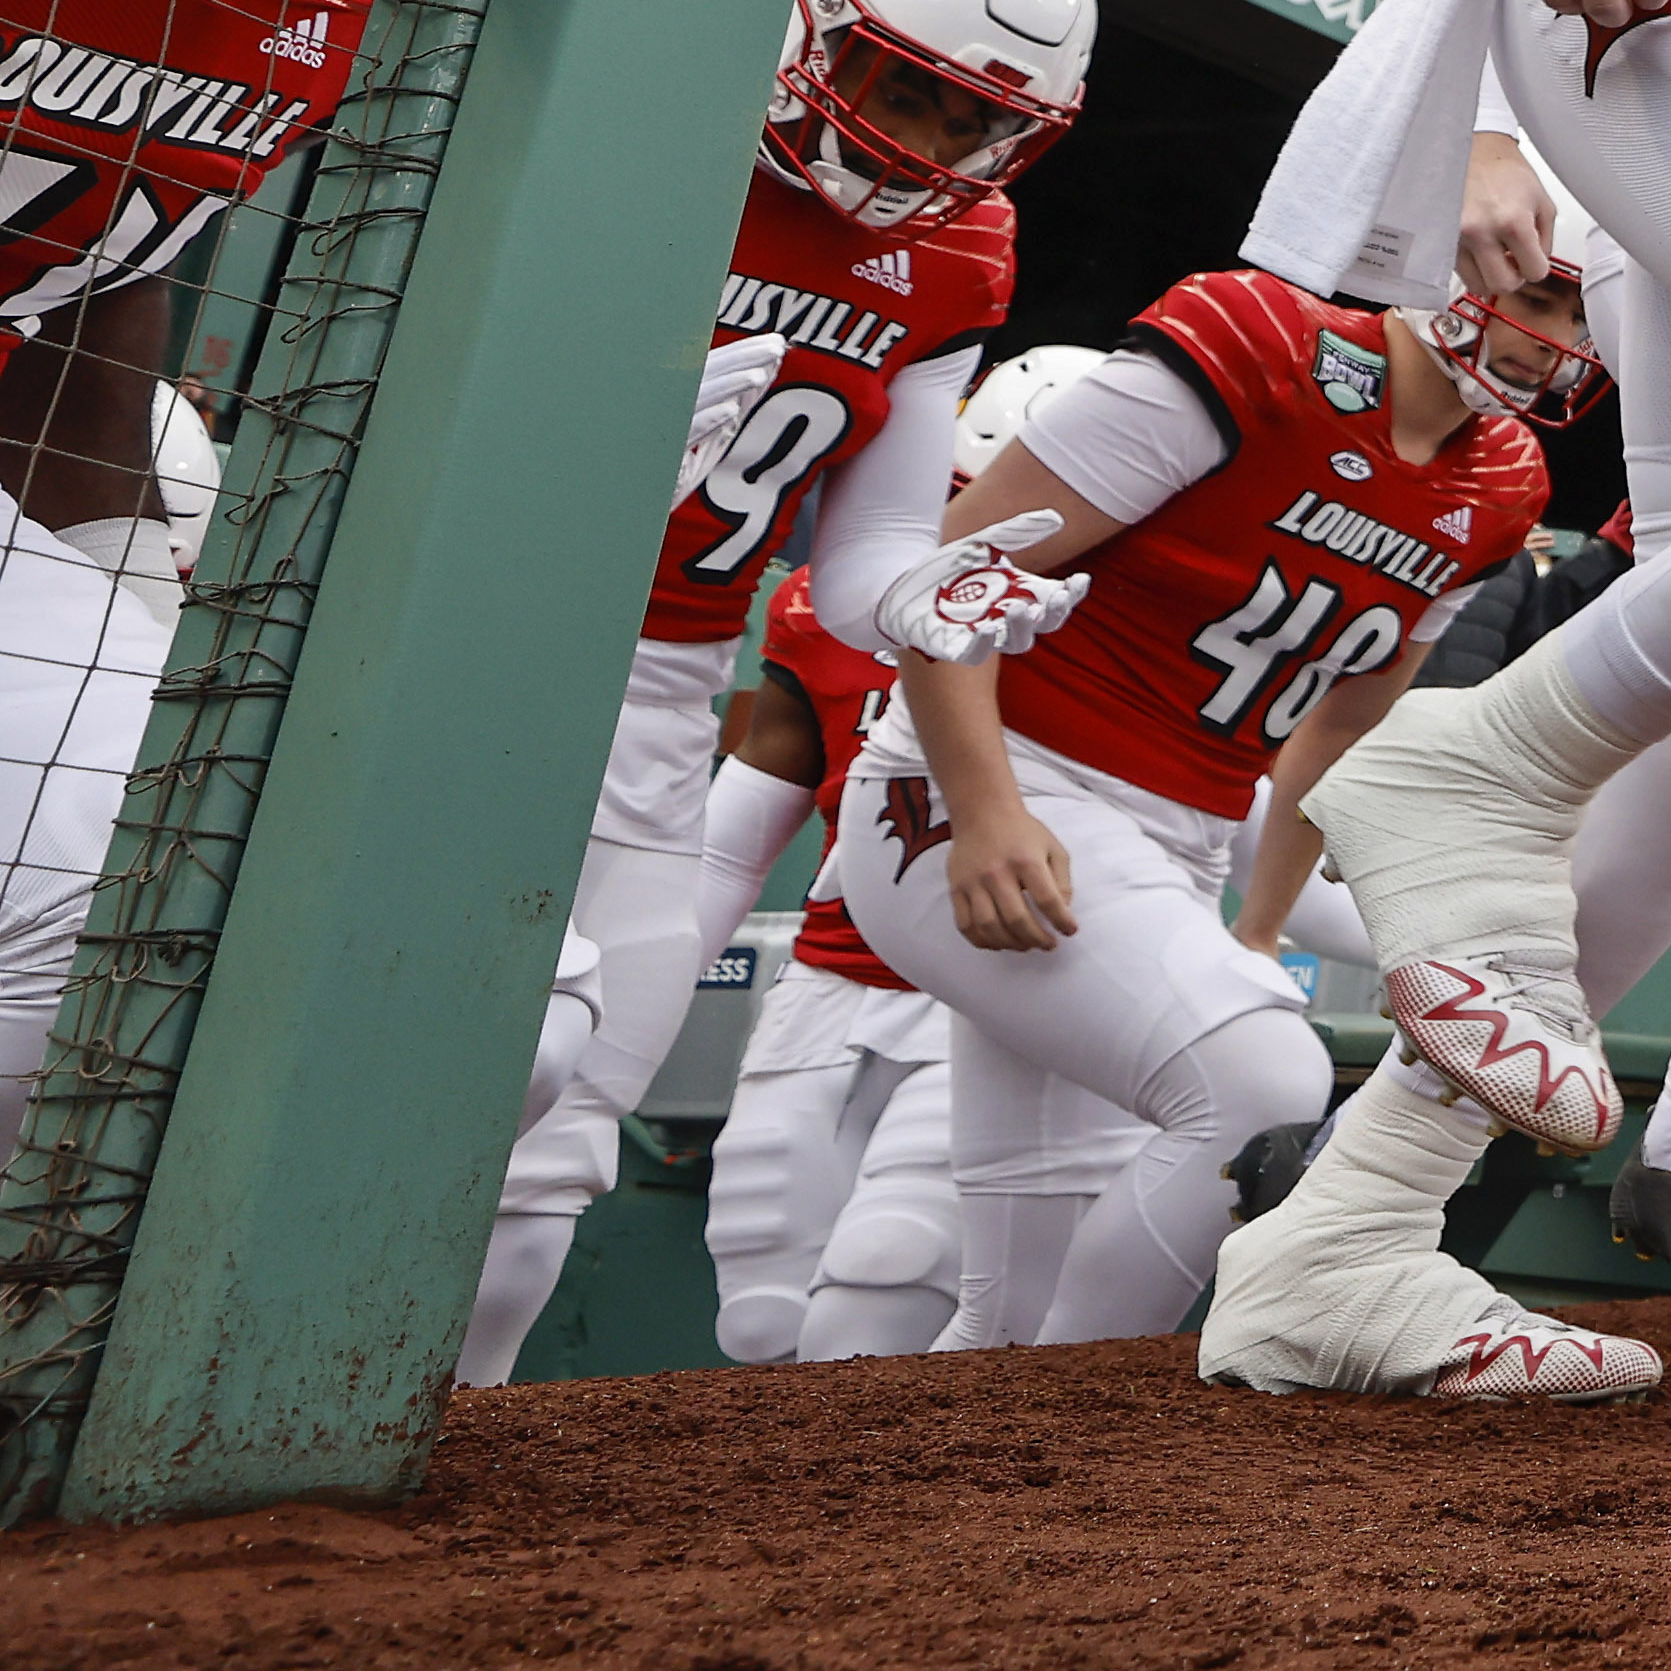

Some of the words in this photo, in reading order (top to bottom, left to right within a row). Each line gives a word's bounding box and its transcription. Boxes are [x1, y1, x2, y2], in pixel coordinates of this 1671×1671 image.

[259, 36, 327, 69] adidas
[851, 263, 914, 296] adidas
[1334, 456, 1367, 477] ACC
[1273, 490, 1462, 598] LOUISVILLE
[1432, 517, 1471, 545] adidas
[1191, 564, 1401, 740] 48
